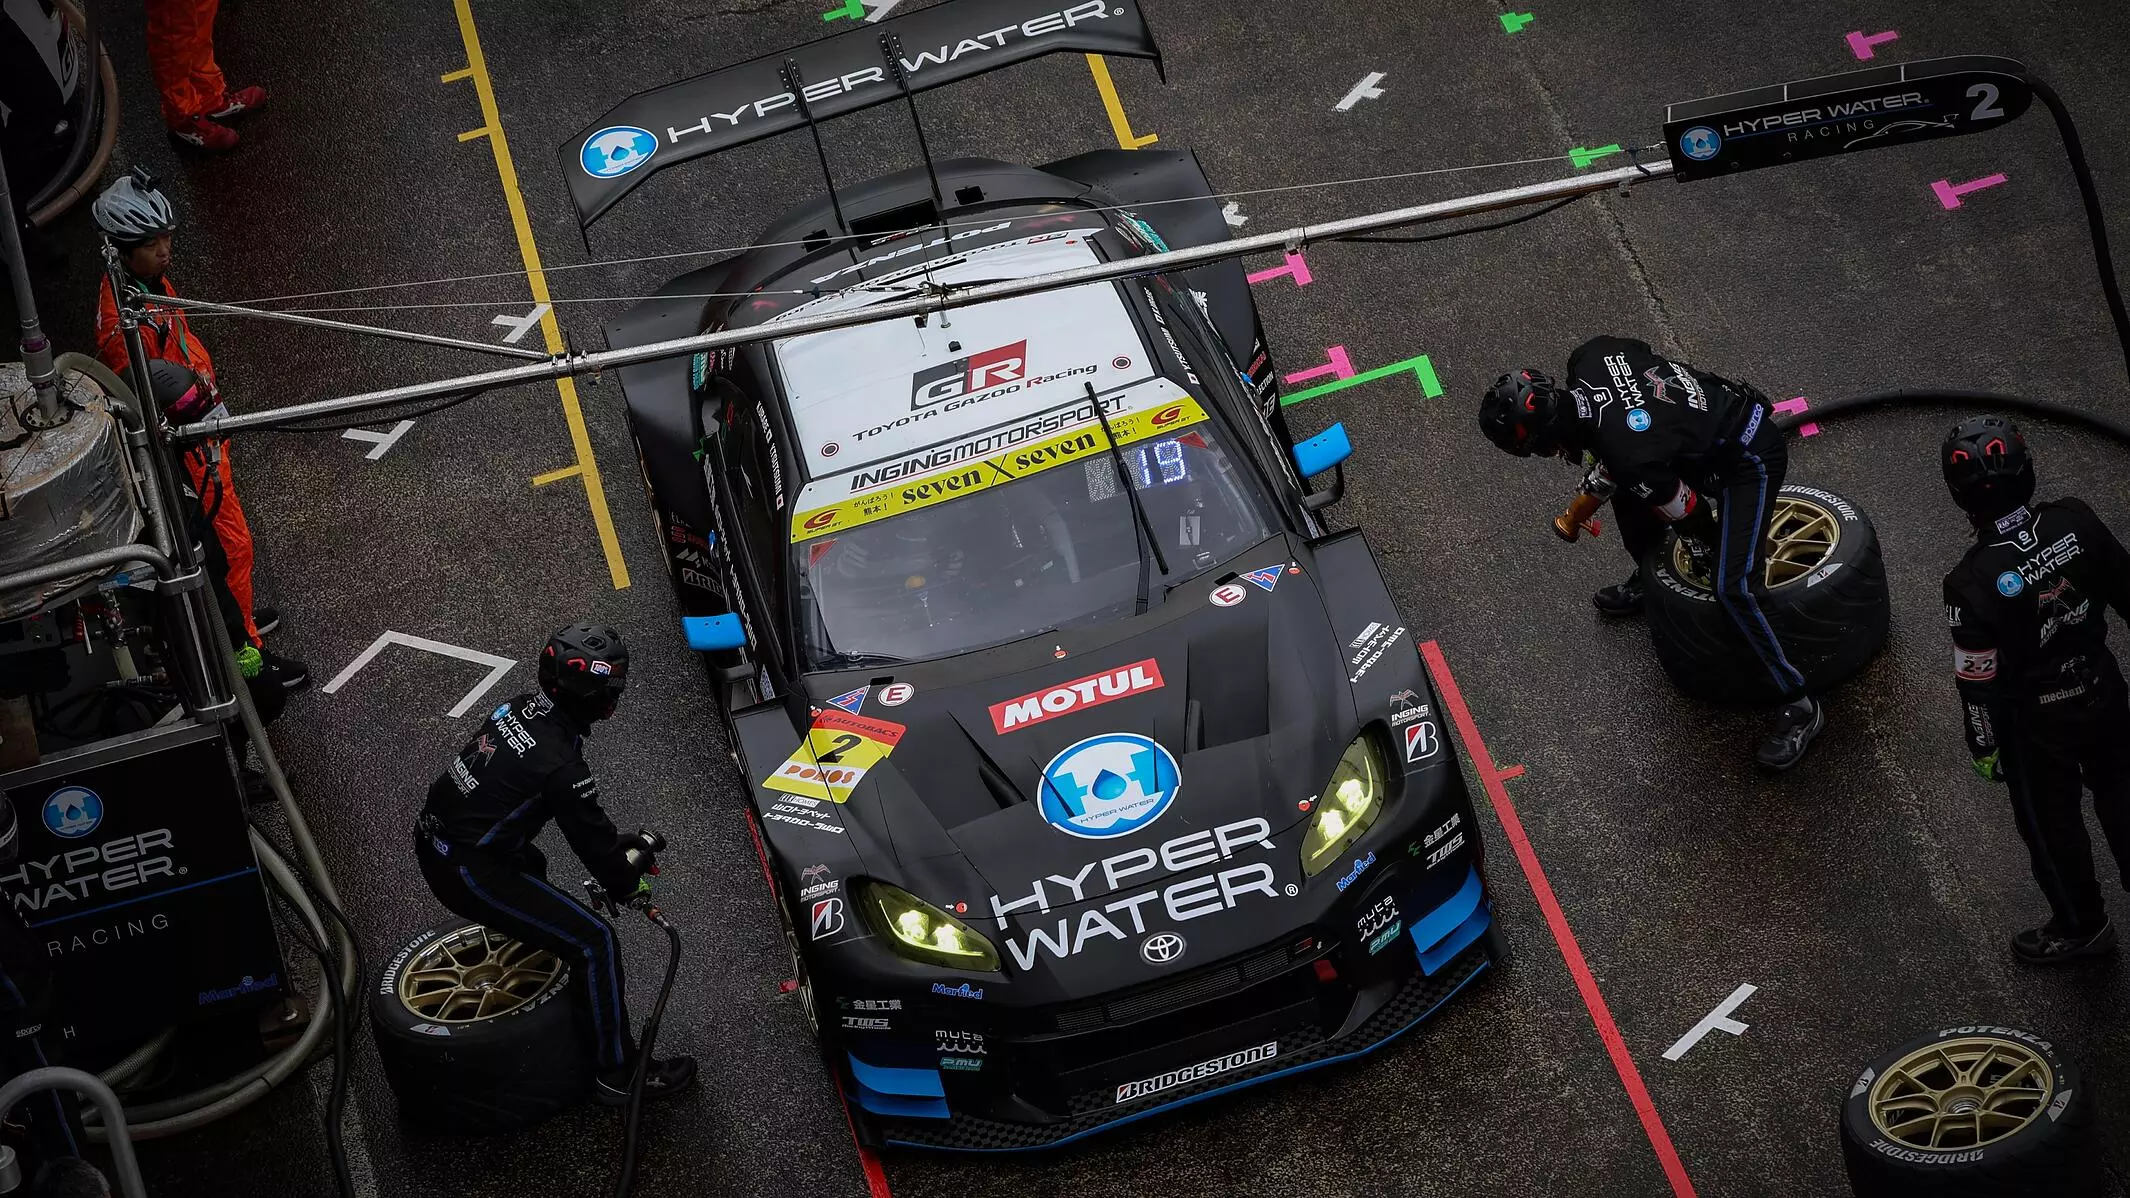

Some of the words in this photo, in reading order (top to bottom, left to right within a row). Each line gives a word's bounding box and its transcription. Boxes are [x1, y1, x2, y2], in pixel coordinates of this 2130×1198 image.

[667, 64, 886, 145] HYPER
[899, 1, 1113, 73] WATER
[1723, 107, 1822, 138] HYPER
[1965, 83, 2005, 121] 2
[1787, 119, 1876, 143] RACING
[852, 410, 939, 442] TOYOTA
[942, 383, 1022, 414] GAZOO
[1025, 364, 1097, 389] Racing
[1603, 355, 1632, 411] HYPER
[1740, 403, 1763, 446] sparco
[903, 470, 982, 506] seven
[1017, 433, 1097, 471] seven
[1141, 439, 1185, 488] 19
[1779, 483, 1859, 522] BRIDGESTONE
[2017, 531, 2079, 575] HYPER
[1655, 567, 1717, 602] TENZA
[1963, 657, 1994, 674] 2-2
[1003, 665, 1155, 730] MOTUL
[1391, 703, 1430, 722] INGING
[504, 710, 537, 750] HYPER
[815, 733, 863, 764] 2
[1080, 806, 1118, 825] HYPER
[1119, 797, 1155, 814] WATER
[800, 878, 840, 898] INGING
[990, 817, 1276, 931] HYPER
[47, 912, 170, 958] RACING
[1003, 861, 1279, 972] WATER
[379, 928, 437, 997] BRIDGESTONE
[1939, 1025, 2053, 1052] POTENZA
[1115, 1041, 1278, 1104] BRIDGESTONE
[1868, 1138, 1985, 1165] BRIDGESTONE
